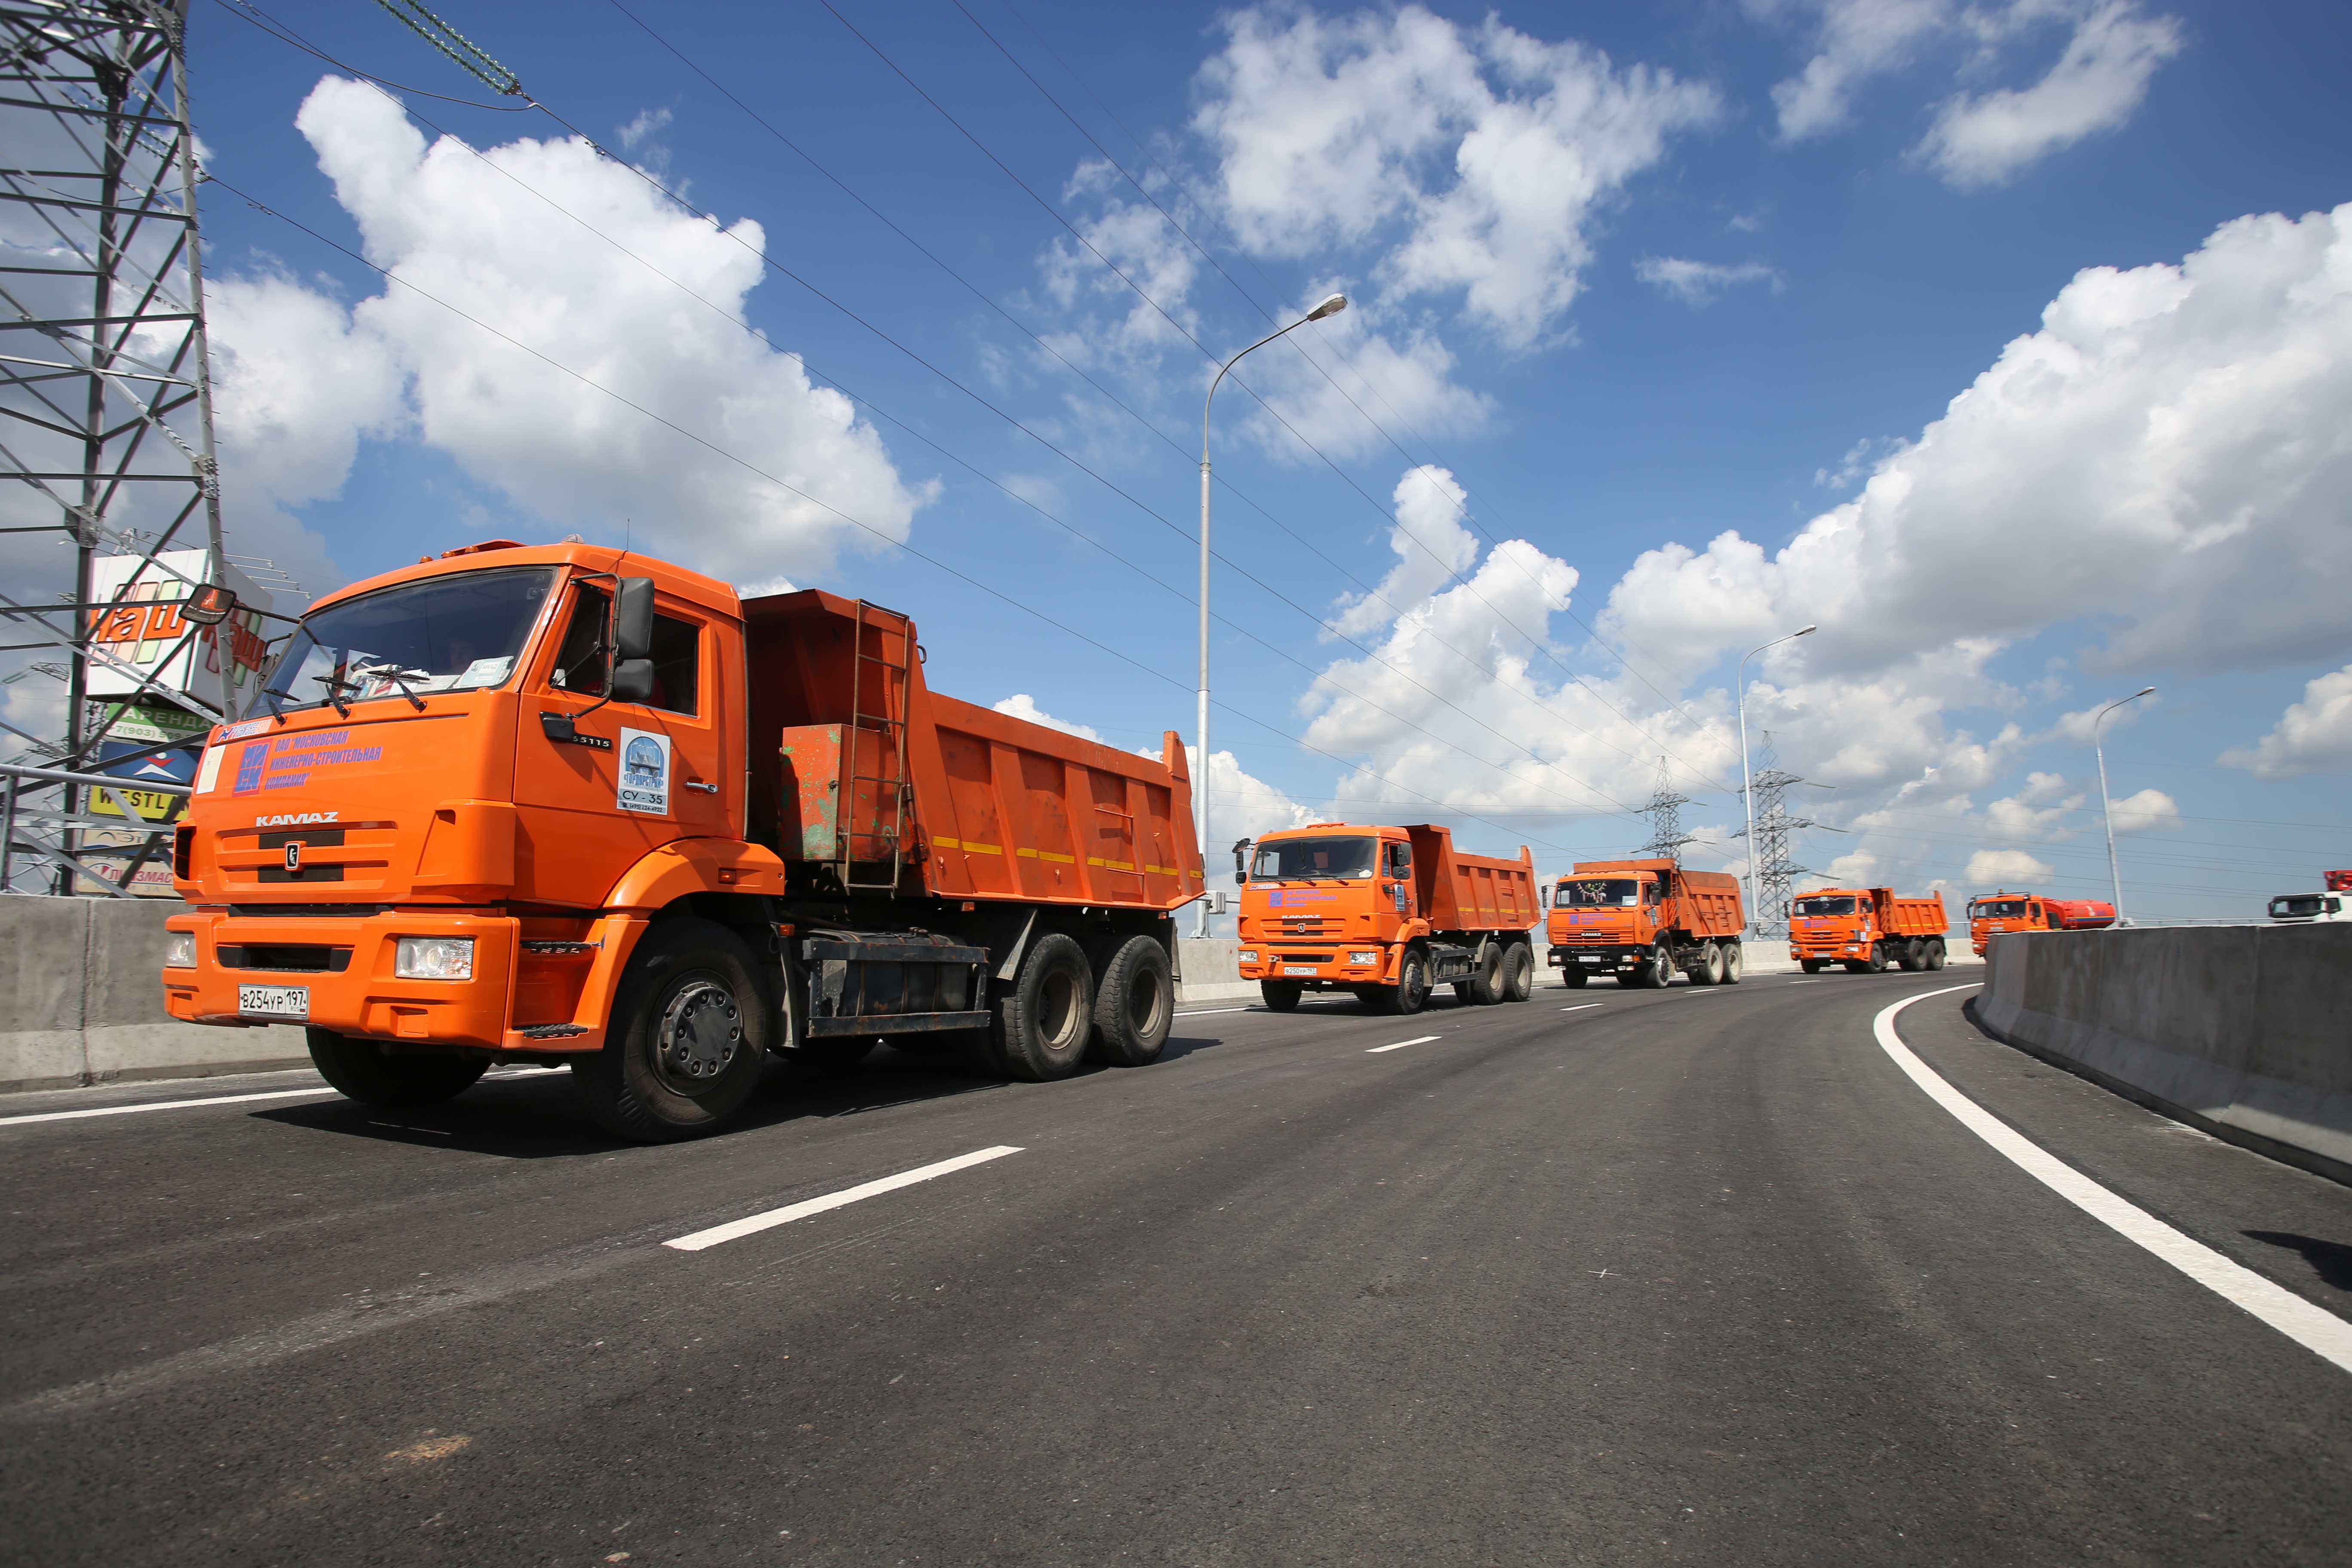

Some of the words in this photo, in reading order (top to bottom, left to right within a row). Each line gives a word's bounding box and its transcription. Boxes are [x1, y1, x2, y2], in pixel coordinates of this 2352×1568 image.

[122, 708, 212, 729] АРЕНДА
[275, 738, 291, 752] ОАО
[269, 746, 383, 771] ИНЖЕНЕРНО-СТРОИТЕЛЬНАЯ
[622, 790, 639, 800] СУ
[649, 794, 662, 804] 35
[255, 811, 339, 827] KAMAZ
[243, 990, 283, 1011] В254УР
[287, 991, 303, 1006] 197
